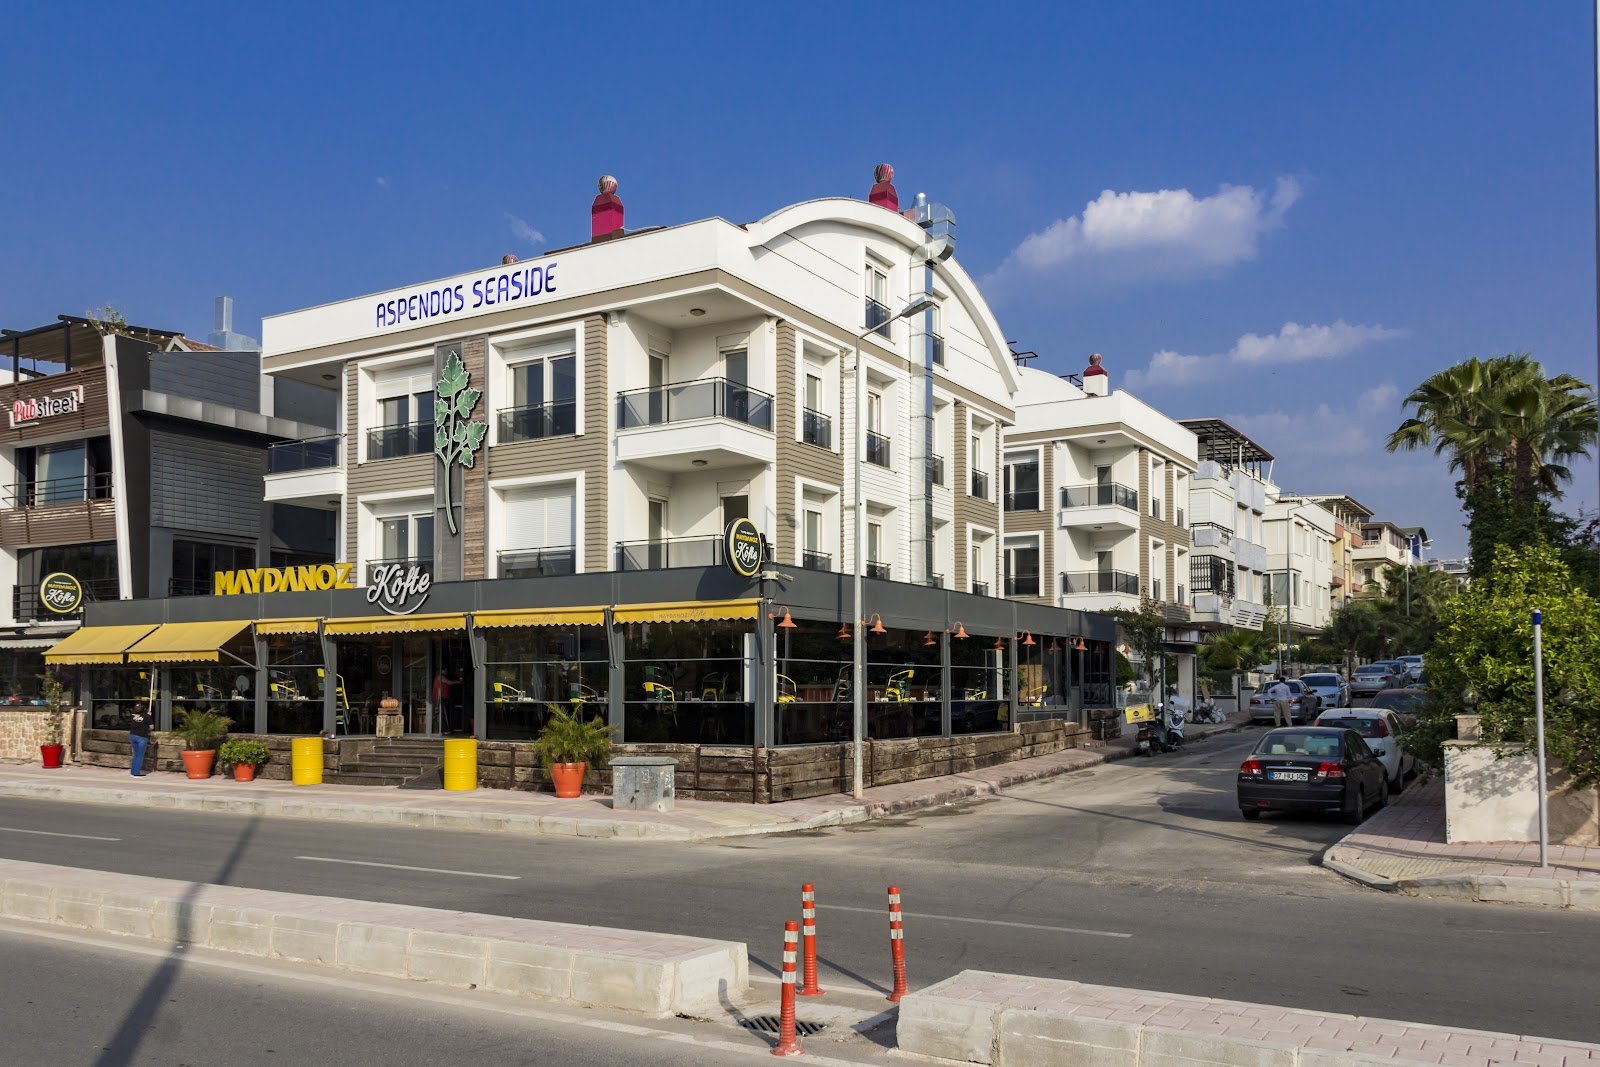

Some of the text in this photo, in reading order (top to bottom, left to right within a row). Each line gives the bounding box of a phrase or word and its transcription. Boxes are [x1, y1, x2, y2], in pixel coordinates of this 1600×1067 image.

[376, 262, 558, 328] ASPENDOS SEASIDE
[736, 533, 759, 544] MAYDANOZ
[736, 542, 758, 562] Köfte
[47, 583, 77, 591] MAYDANOZ
[214, 563, 354, 596] MAYDANOZ
[366, 563, 431, 605] Köfte
[46, 589, 75, 604] Köfte
